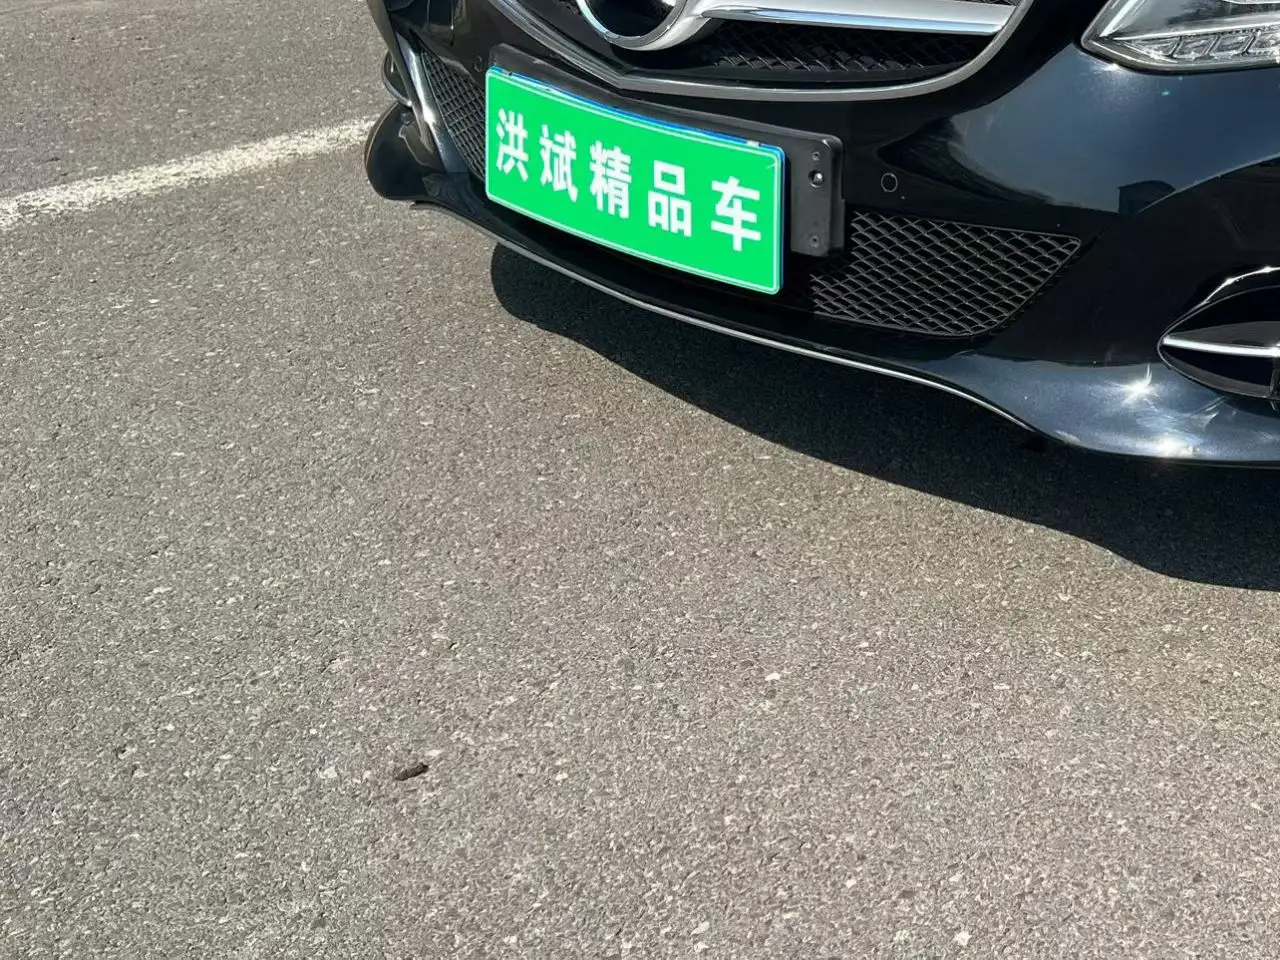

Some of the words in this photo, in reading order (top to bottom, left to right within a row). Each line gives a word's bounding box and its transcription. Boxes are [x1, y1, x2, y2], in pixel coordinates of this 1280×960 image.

[495, 108, 762, 252] 洪斌精品车
